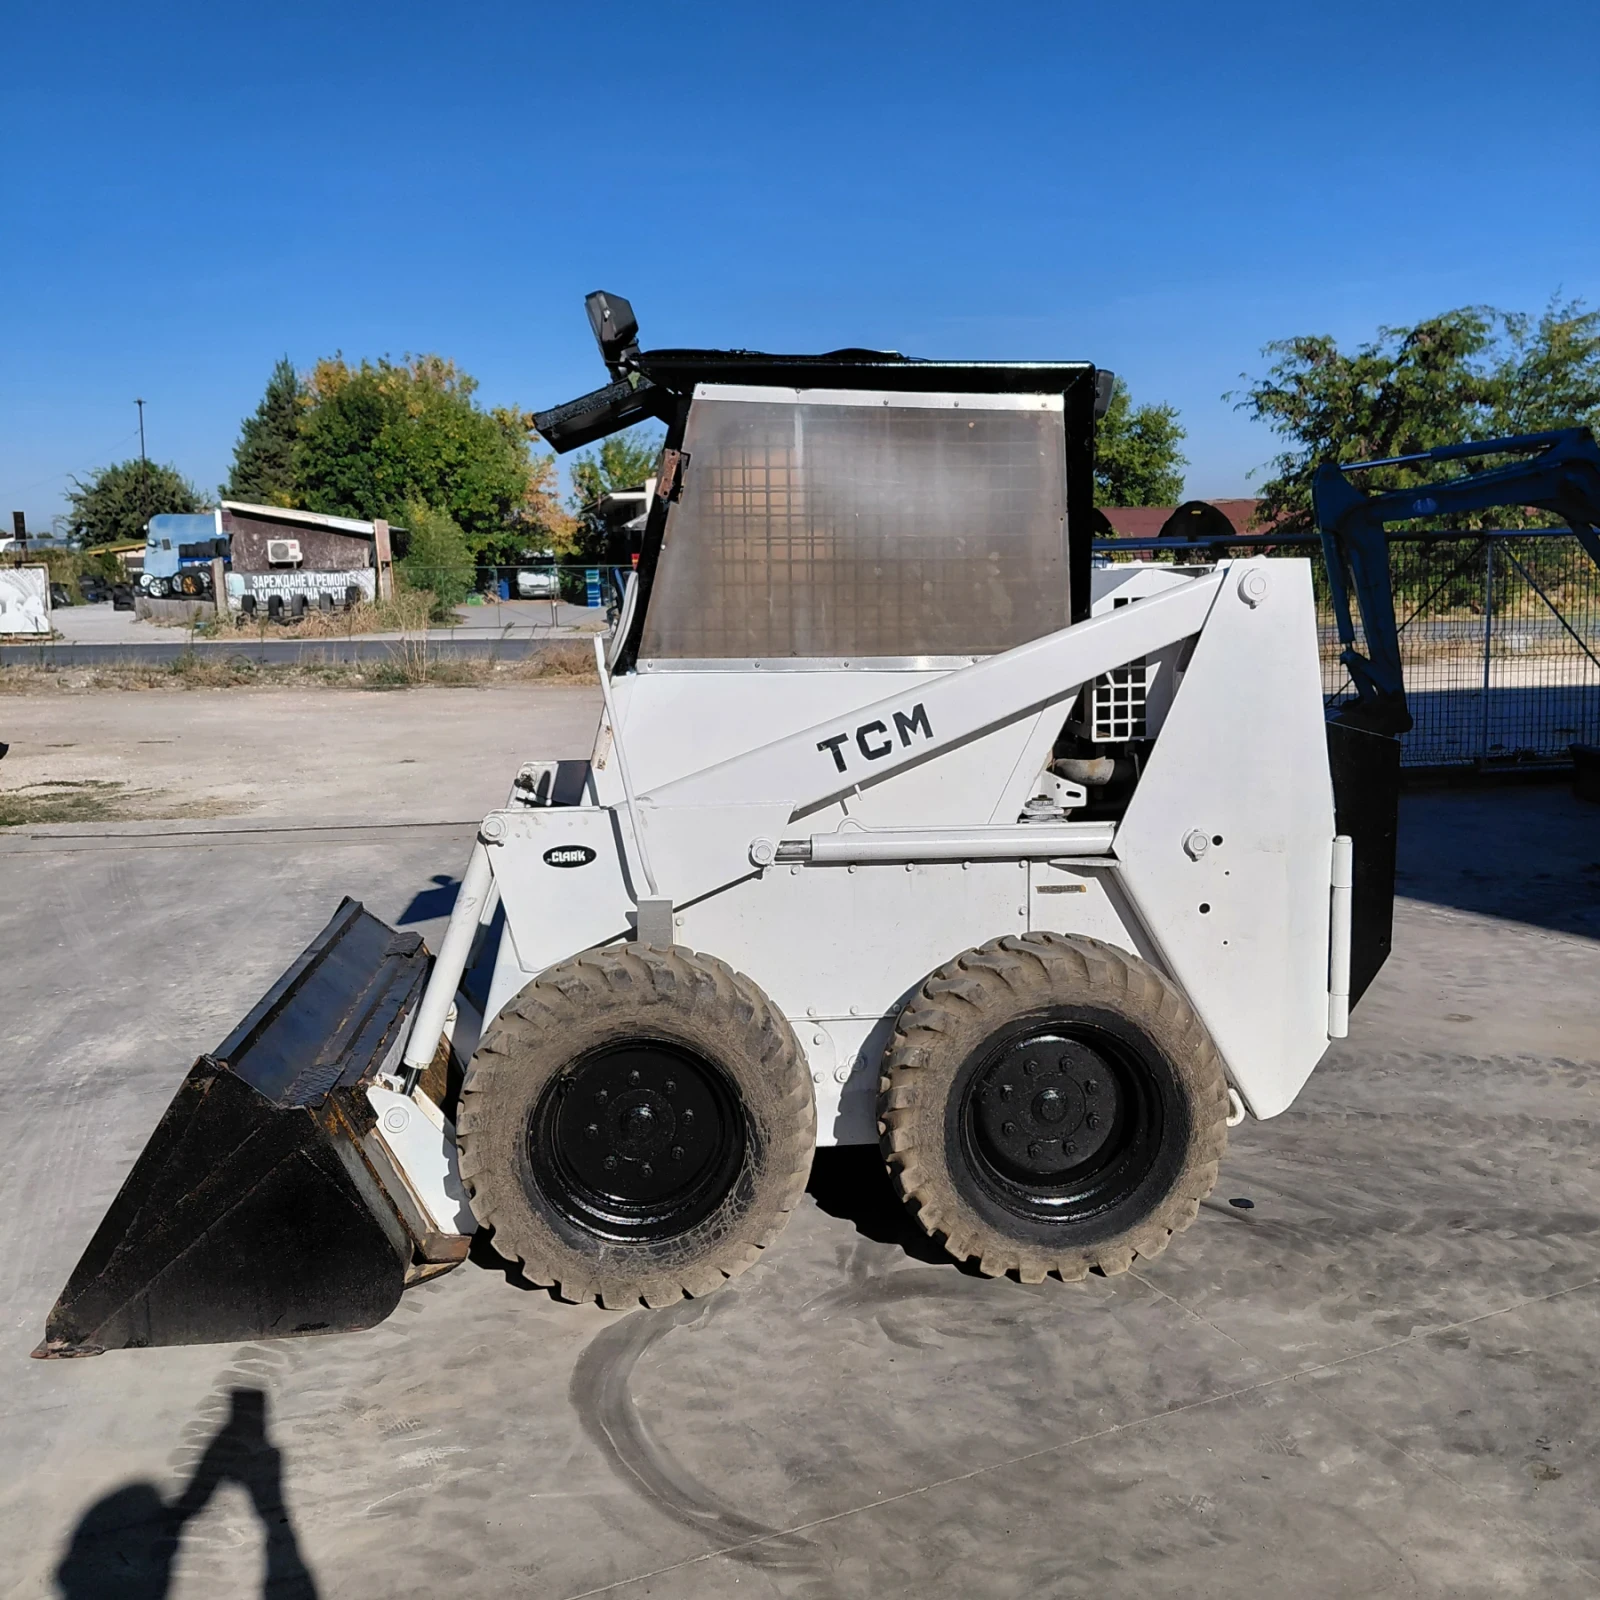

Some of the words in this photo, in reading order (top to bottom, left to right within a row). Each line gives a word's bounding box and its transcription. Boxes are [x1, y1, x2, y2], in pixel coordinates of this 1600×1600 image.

[252, 574, 307, 589] ЗАРЕЖДАНЕ
[308, 573, 316, 587] И
[316, 573, 350, 587] РЕМОНТ
[816, 702, 934, 774] TCM
[551, 850, 587, 863] CLARK
